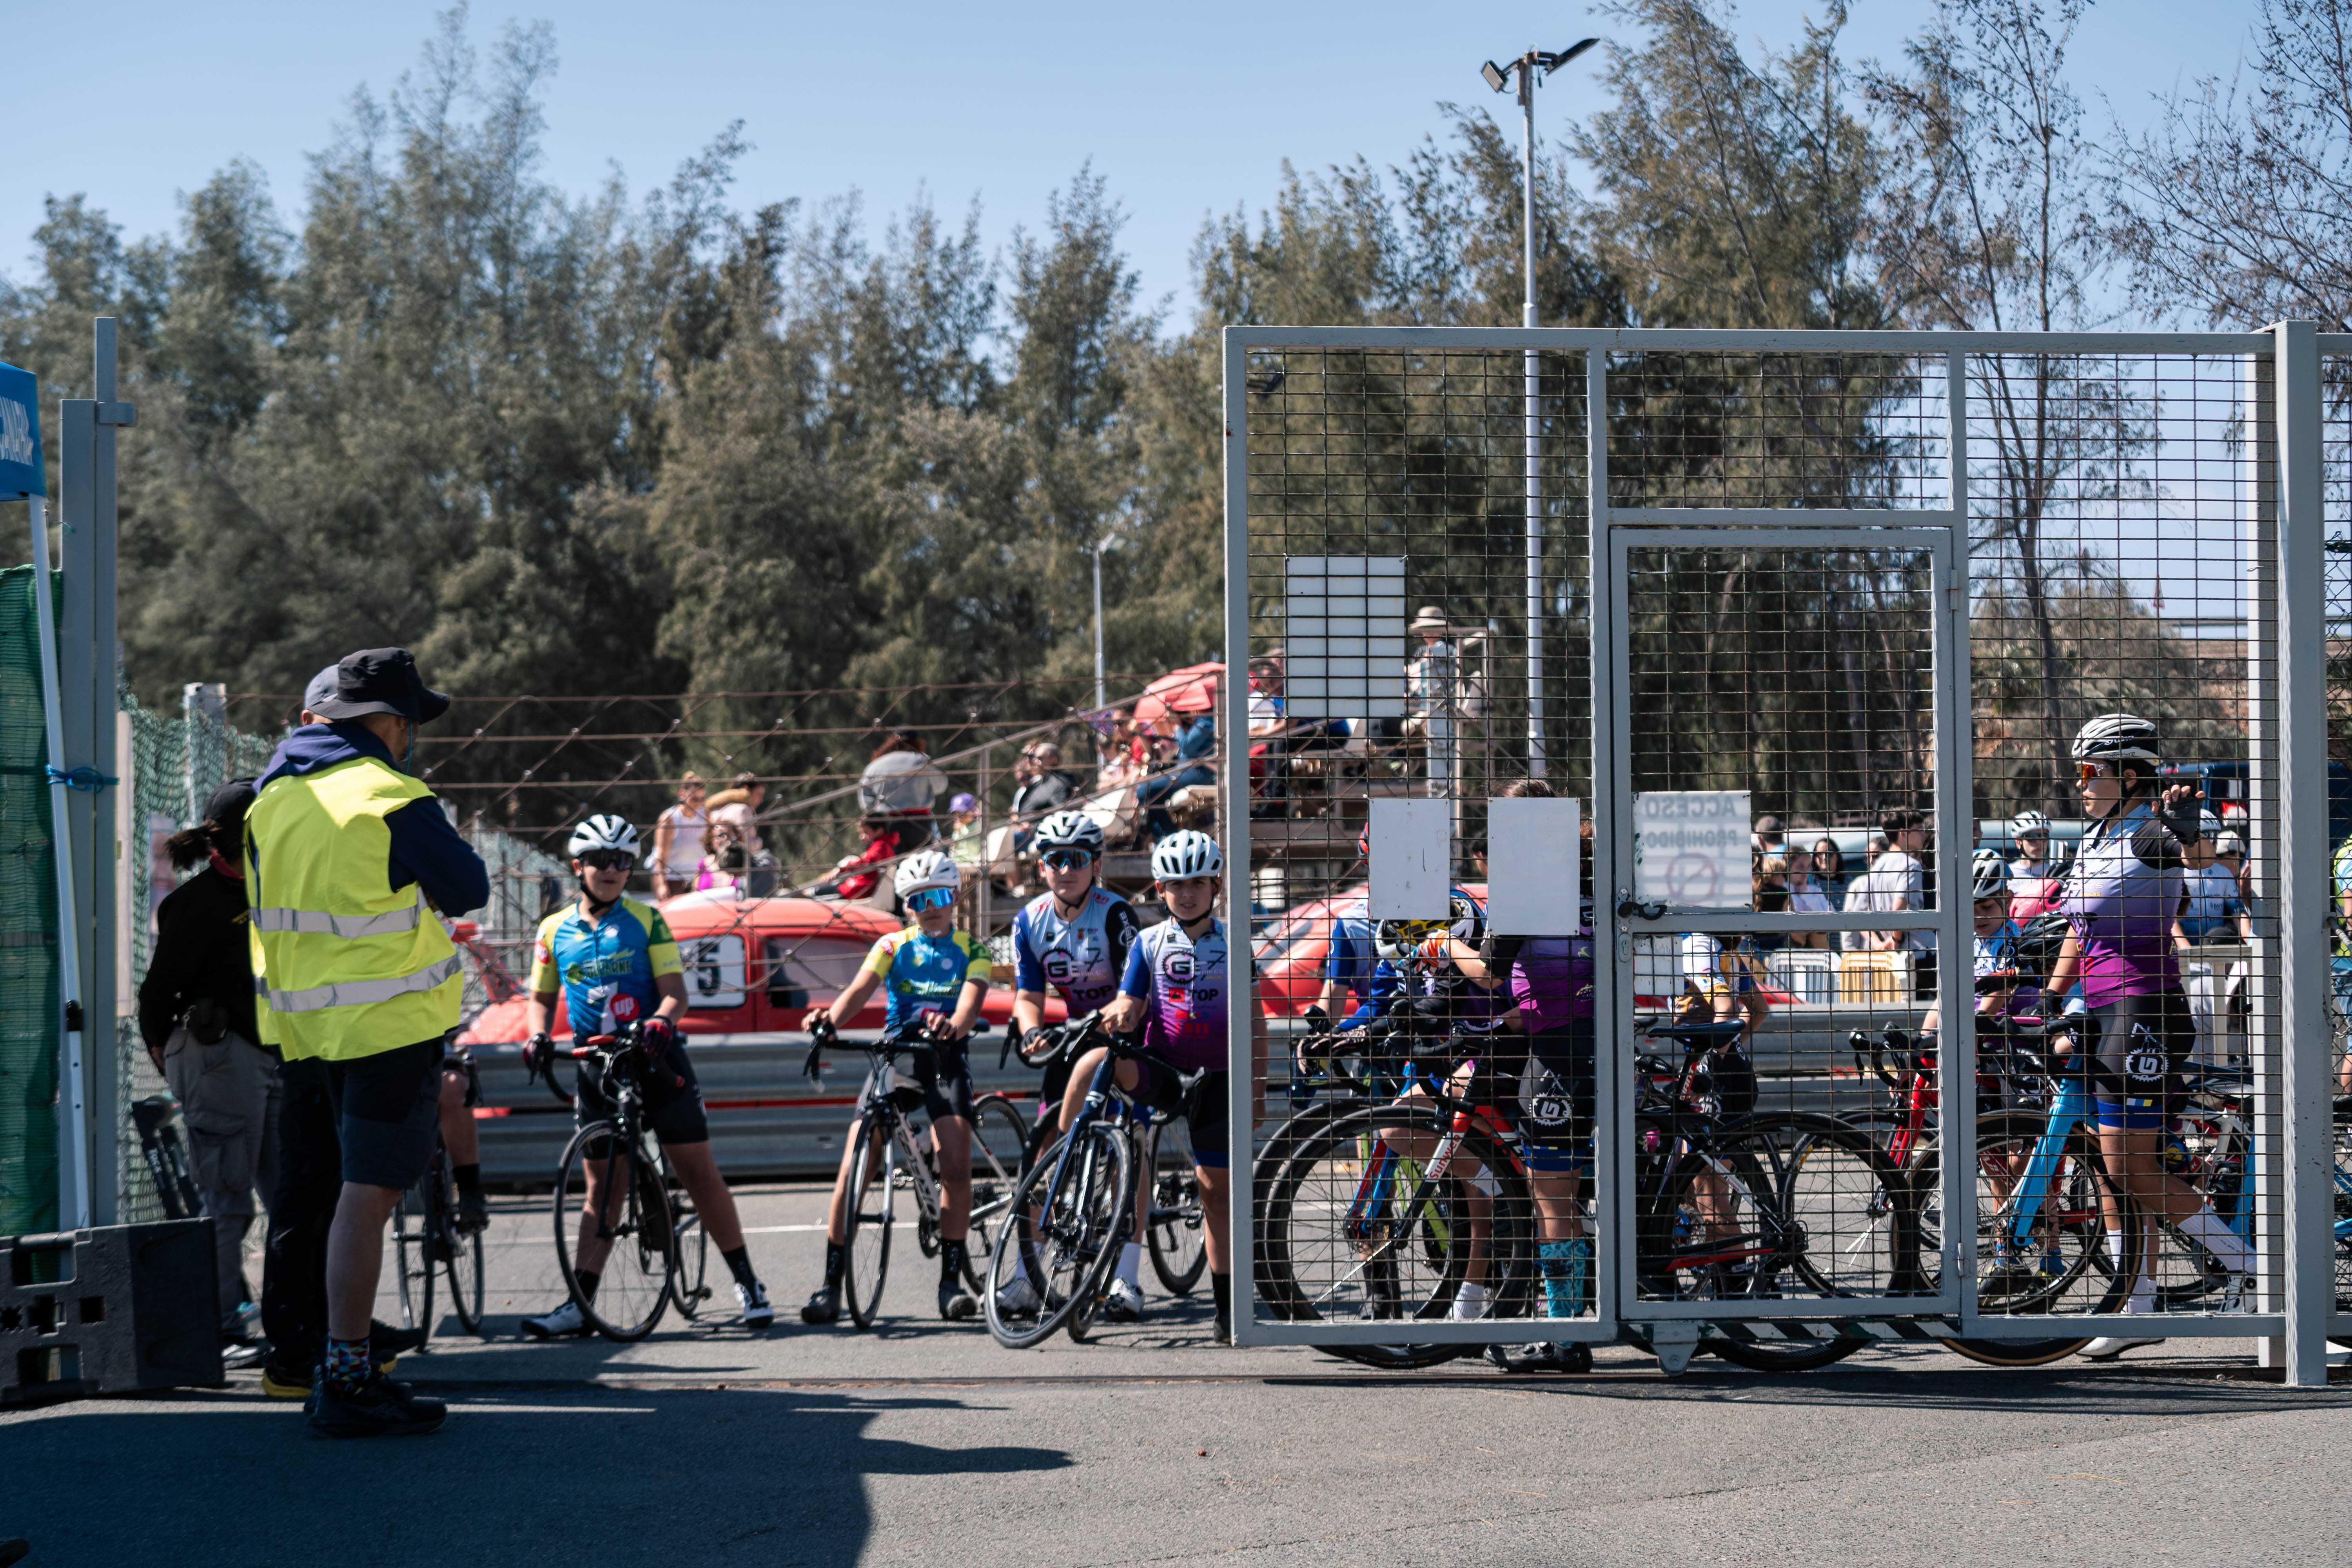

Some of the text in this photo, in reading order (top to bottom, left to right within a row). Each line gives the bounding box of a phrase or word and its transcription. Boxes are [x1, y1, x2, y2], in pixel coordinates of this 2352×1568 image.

[697, 941, 721, 998] 5
[1073, 985, 1112, 1000] TOP
[1189, 988, 1218, 1001] TOP
[614, 996, 635, 1017] up
